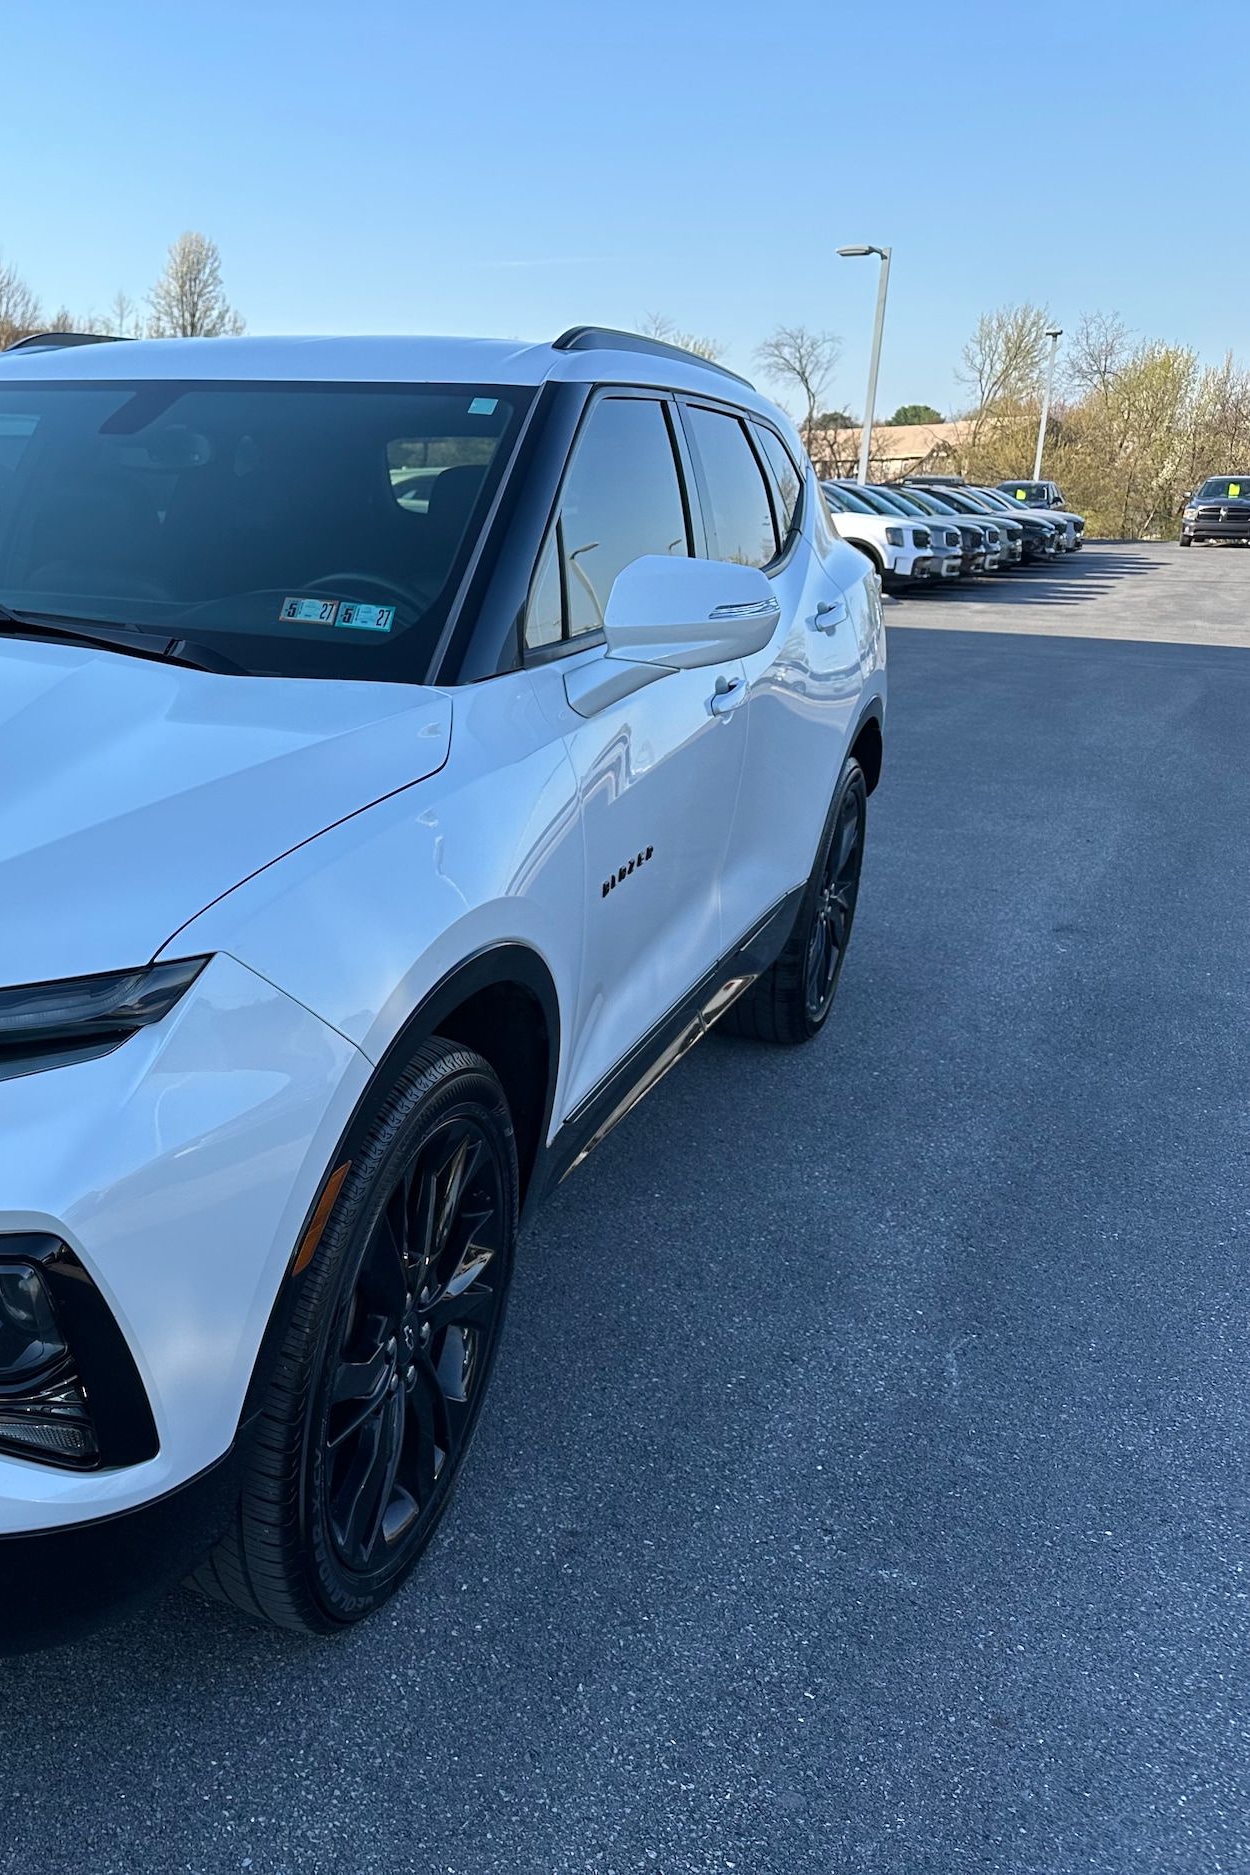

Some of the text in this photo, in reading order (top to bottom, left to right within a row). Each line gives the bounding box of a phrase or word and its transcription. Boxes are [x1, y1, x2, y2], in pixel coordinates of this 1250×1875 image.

[286, 603, 335, 622] 5 27
[342, 608, 391, 628] 5 27
[601, 844, 654, 899] BLAZER
